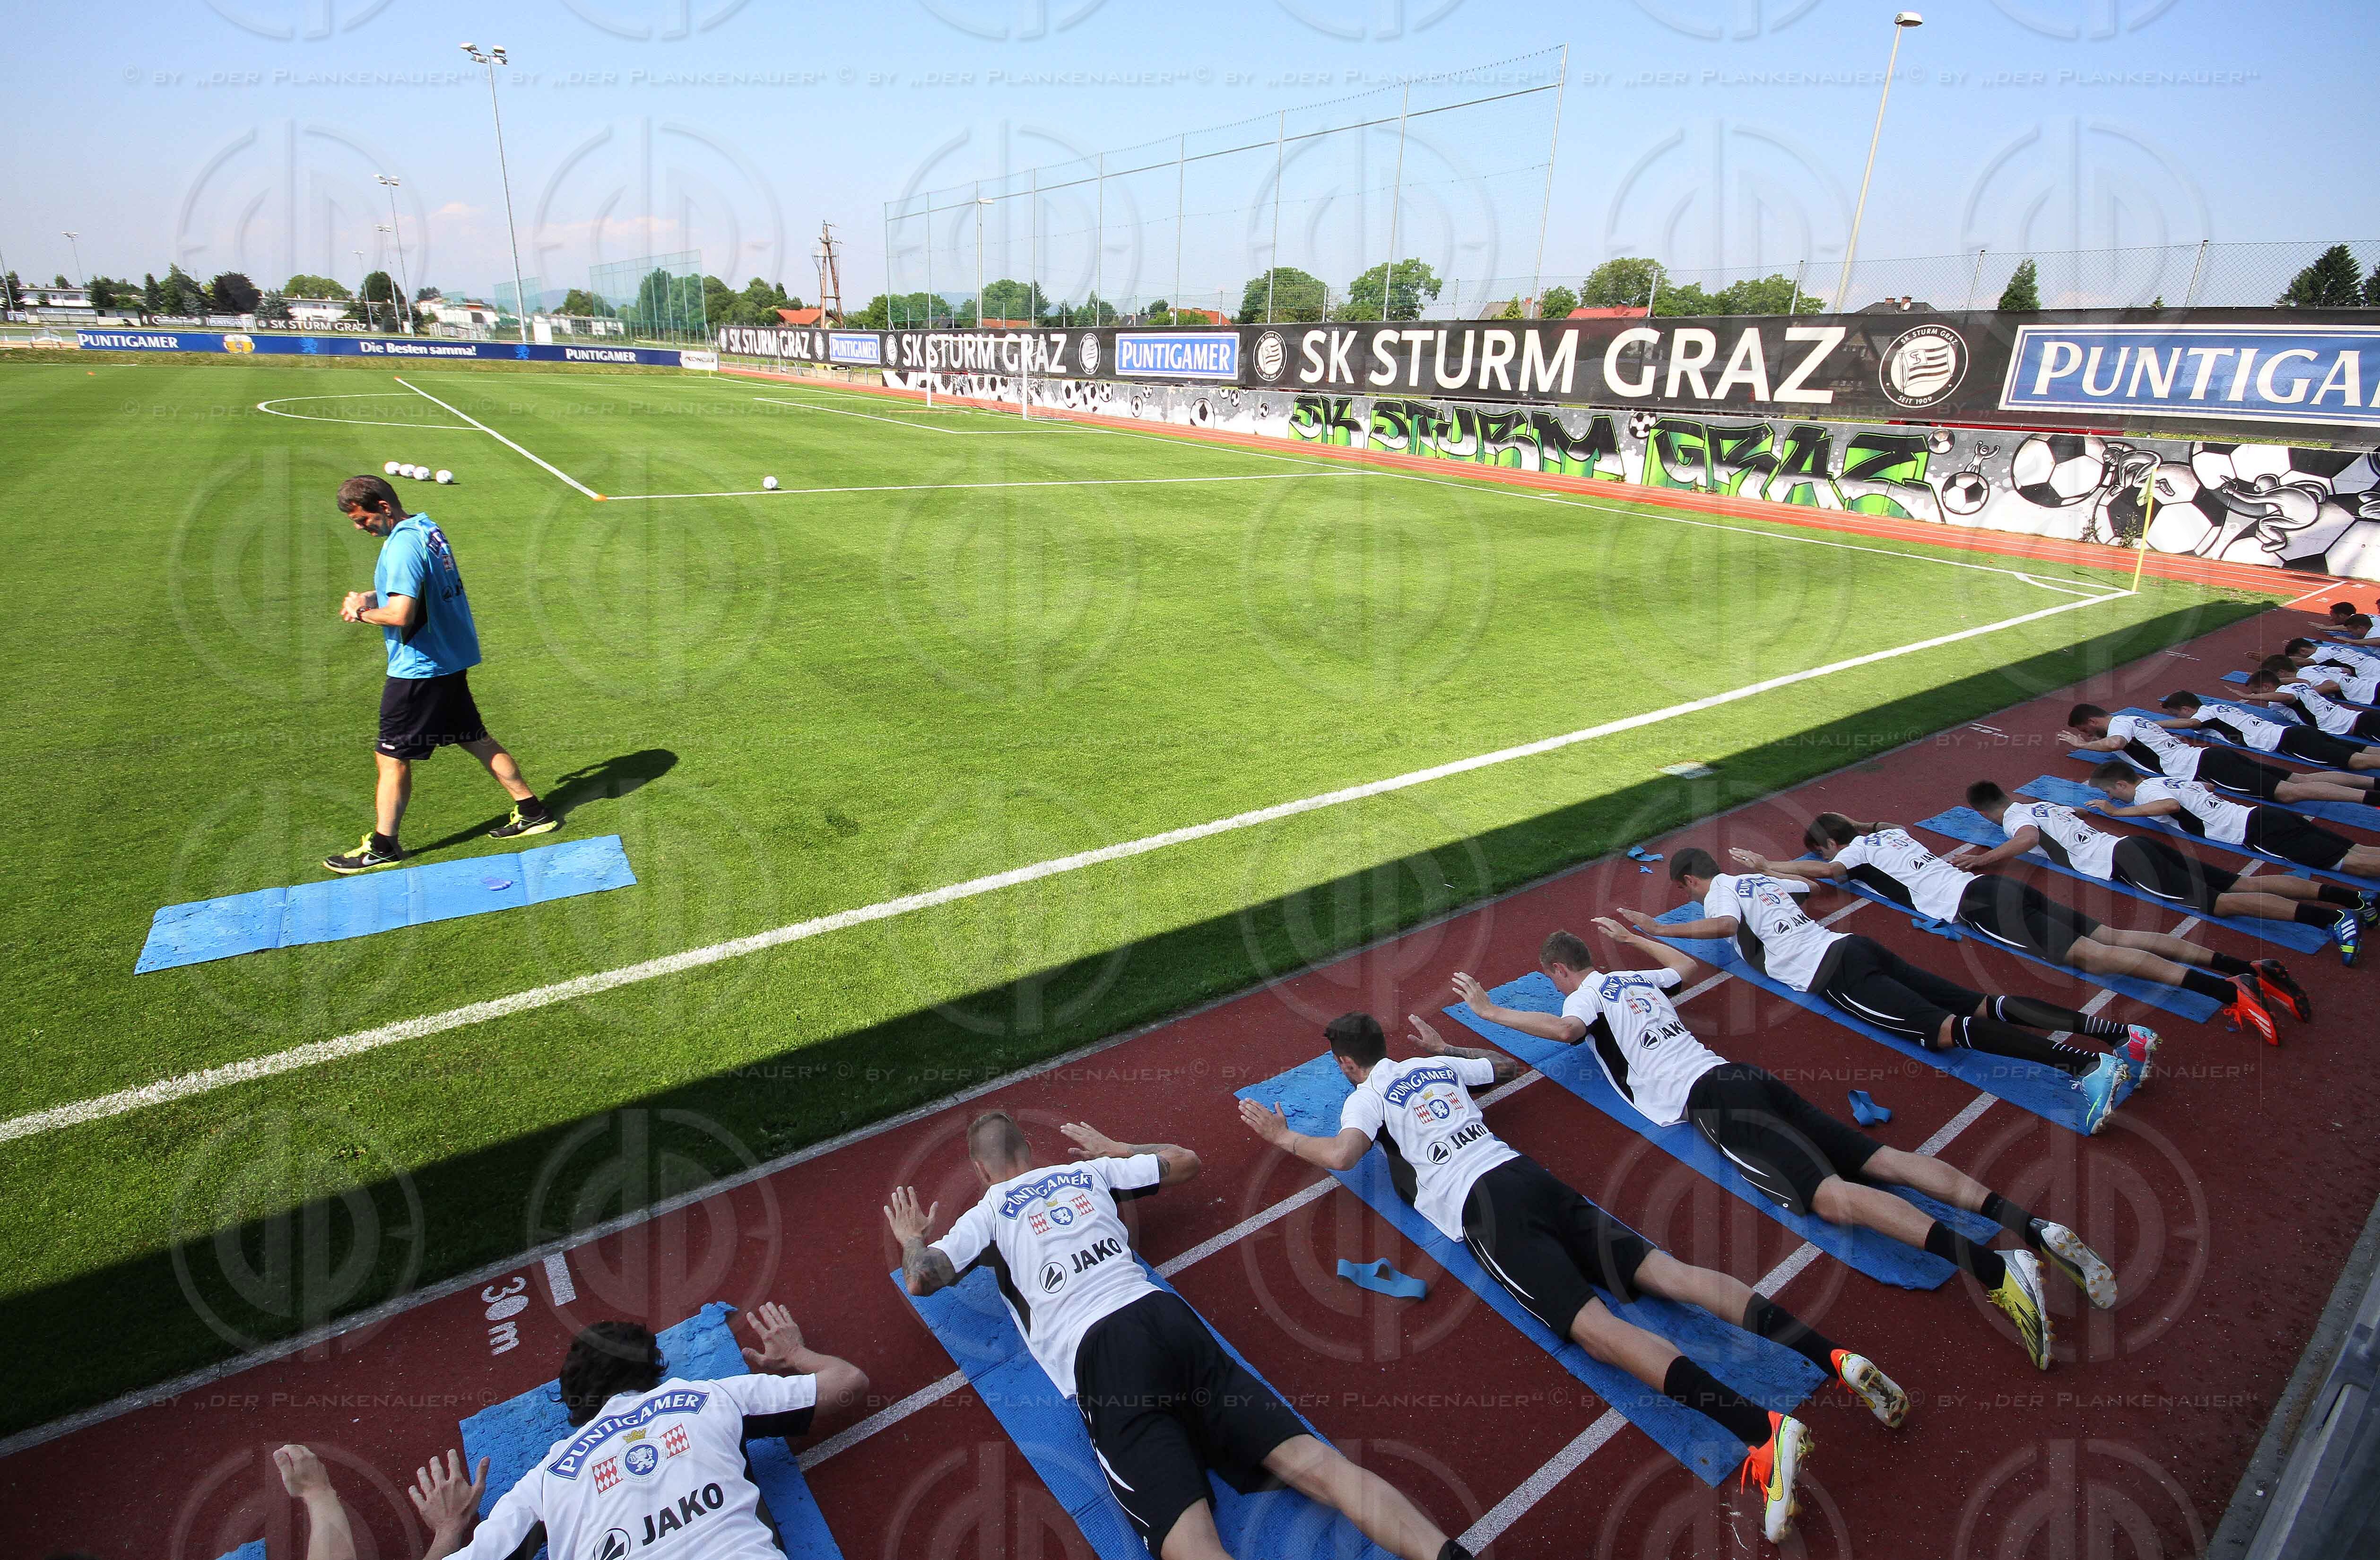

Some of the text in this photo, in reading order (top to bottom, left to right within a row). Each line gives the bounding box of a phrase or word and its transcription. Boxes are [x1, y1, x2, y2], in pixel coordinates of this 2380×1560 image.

[78, 333, 179, 348] PUNTIGAMER
[270, 320, 367, 331] SK STURM GRAZ
[1900, 328, 1959, 346] SK STURM GRAZ
[359, 341, 477, 355] Die Besten samma!
[565, 348, 636, 362] PUNTIGAMER
[729, 329, 811, 359] SK STURM GRAZ
[832, 338, 878, 360] PUNTIGAMER
[902, 333, 1067, 373] SK STURM GRAZ
[1122, 340, 1230, 372] PUNTIGAMER
[1299, 326, 1846, 404] SK STURM GRAZ
[2031, 341, 2380, 408] PUNTIGA
[1897, 395, 1933, 405] SEIT 1909
[1288, 395, 1946, 524] SK STURM GRAZ
[1070, 1237, 1121, 1274] JAKO
[558, 1393, 699, 1474] PUNTIGAMER
[641, 1482, 724, 1546] JAKO
